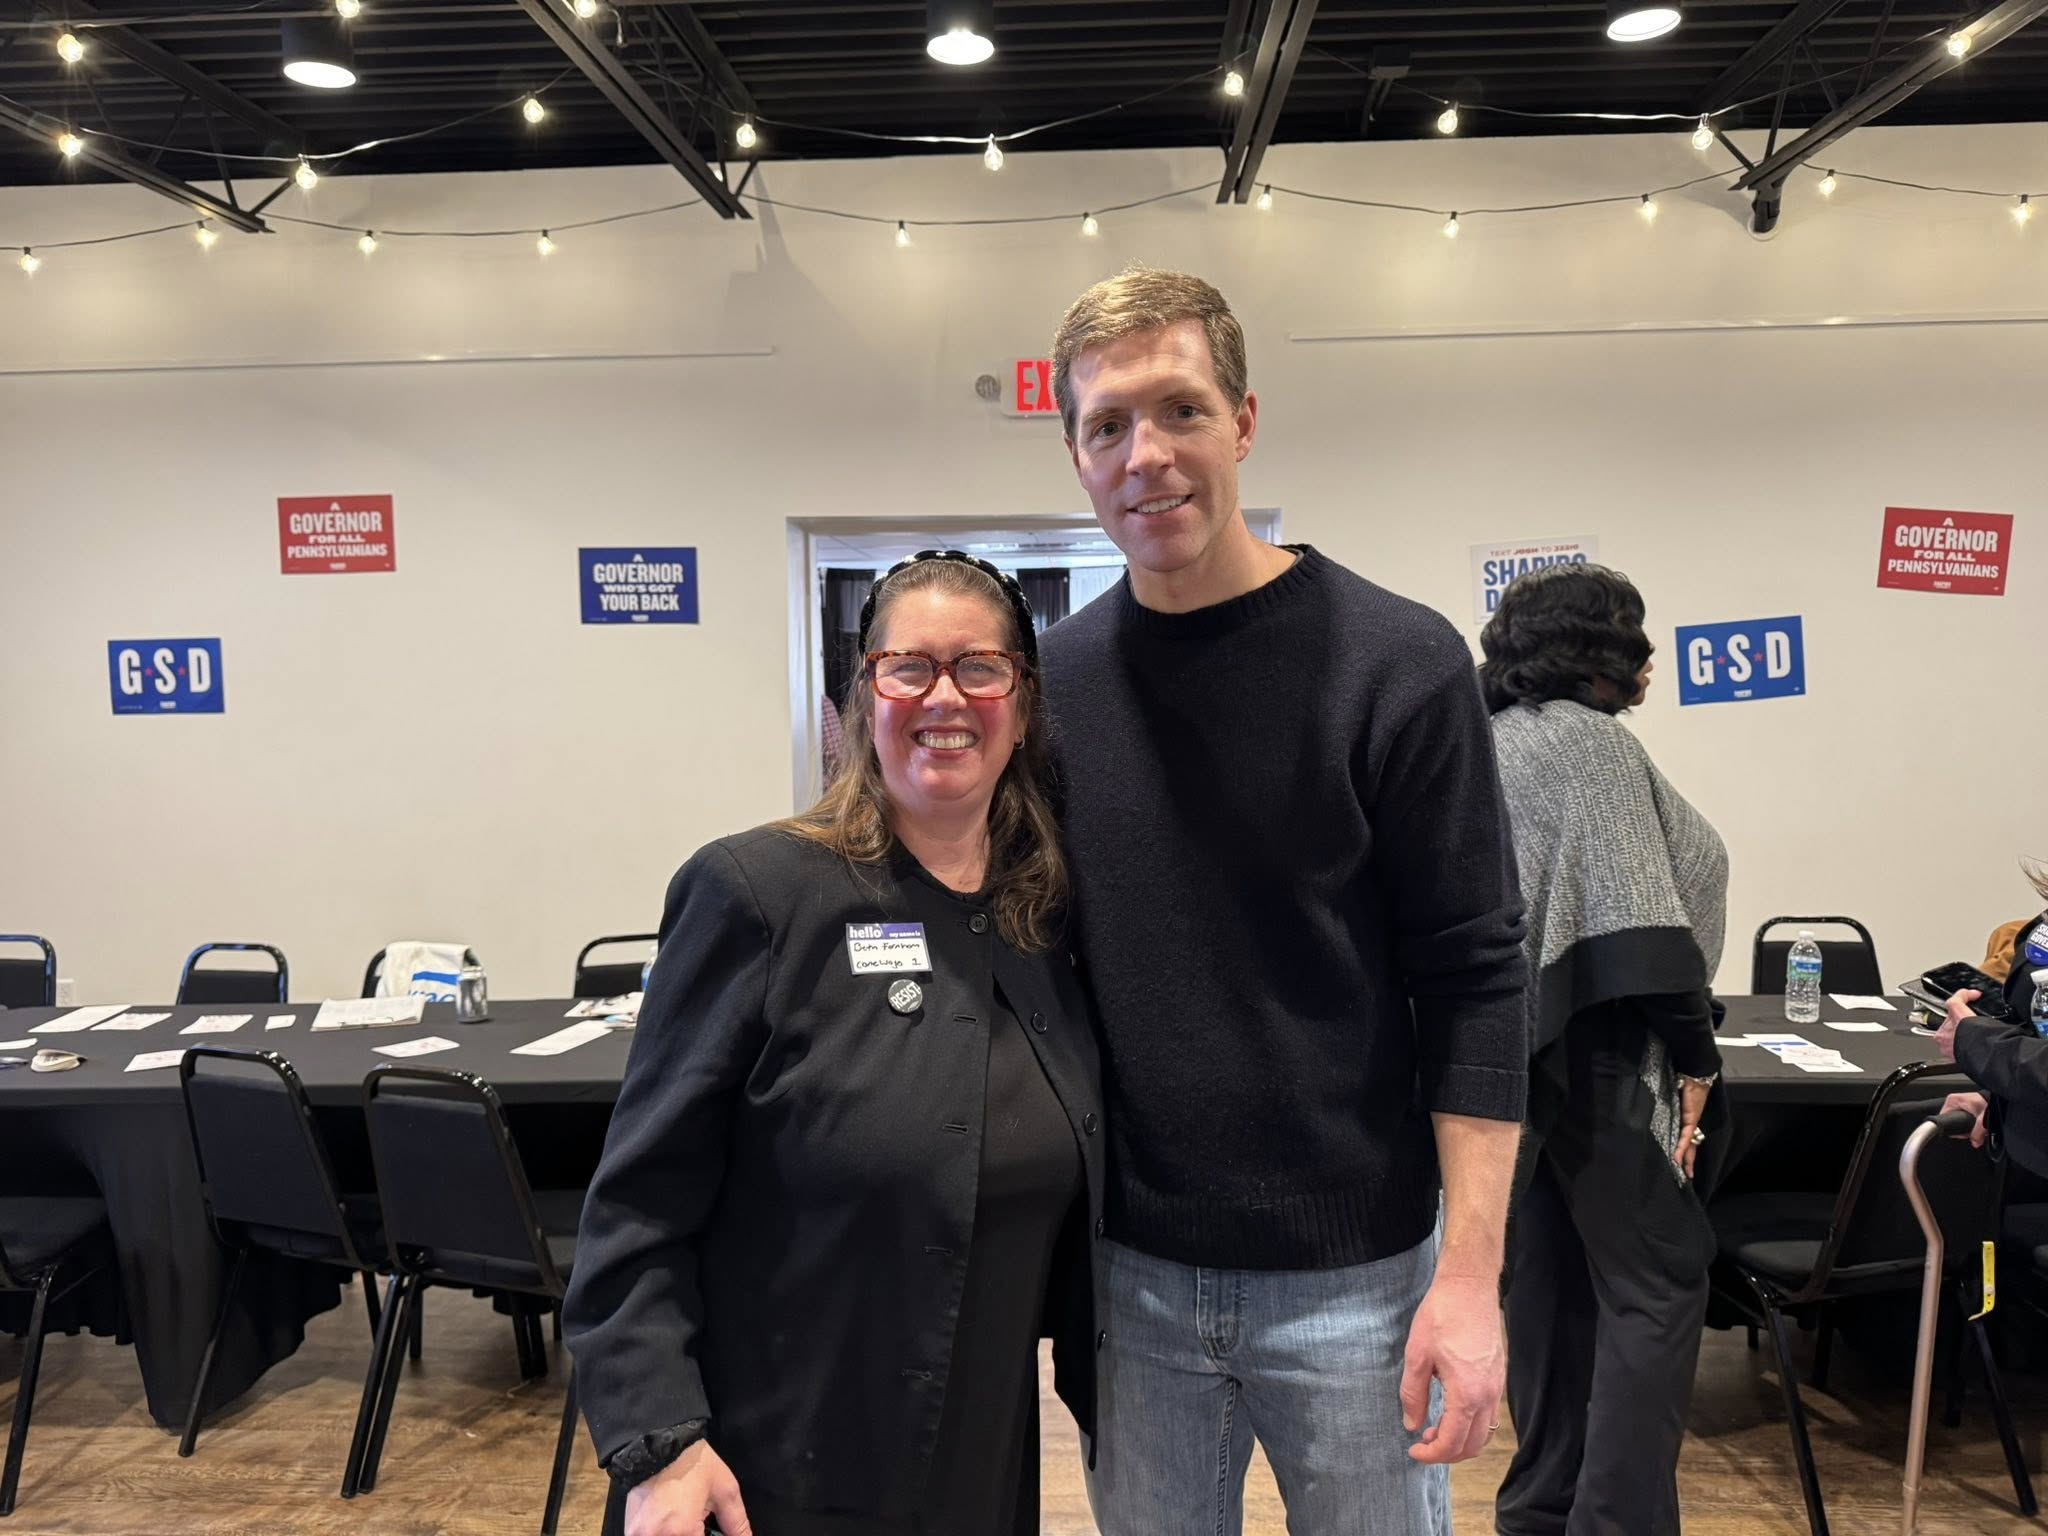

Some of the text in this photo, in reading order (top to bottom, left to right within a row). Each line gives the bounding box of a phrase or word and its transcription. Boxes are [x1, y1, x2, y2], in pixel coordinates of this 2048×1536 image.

[1017, 361, 1053, 411] EX
[330, 501, 341, 511] A
[290, 511, 383, 534] GOVERNOR
[1942, 517, 1954, 527] A
[308, 534, 366, 544] FOR ALL
[1895, 525, 1998, 552] GOVERNOR
[287, 543, 388, 559] PENNSYLVANIANS
[632, 554, 644, 562] A
[1914, 550, 1976, 562] FOR ALL
[593, 563, 684, 583] GOVERNOR
[1887, 559, 1999, 579] PENNSYLVANIANS
[603, 584, 676, 593] WHO'S GOT
[600, 594, 680, 611] YOUR BACK
[849, 926, 881, 939] hello
[854, 942, 878, 952] Beth
[890, 982, 921, 1009] RESIST
